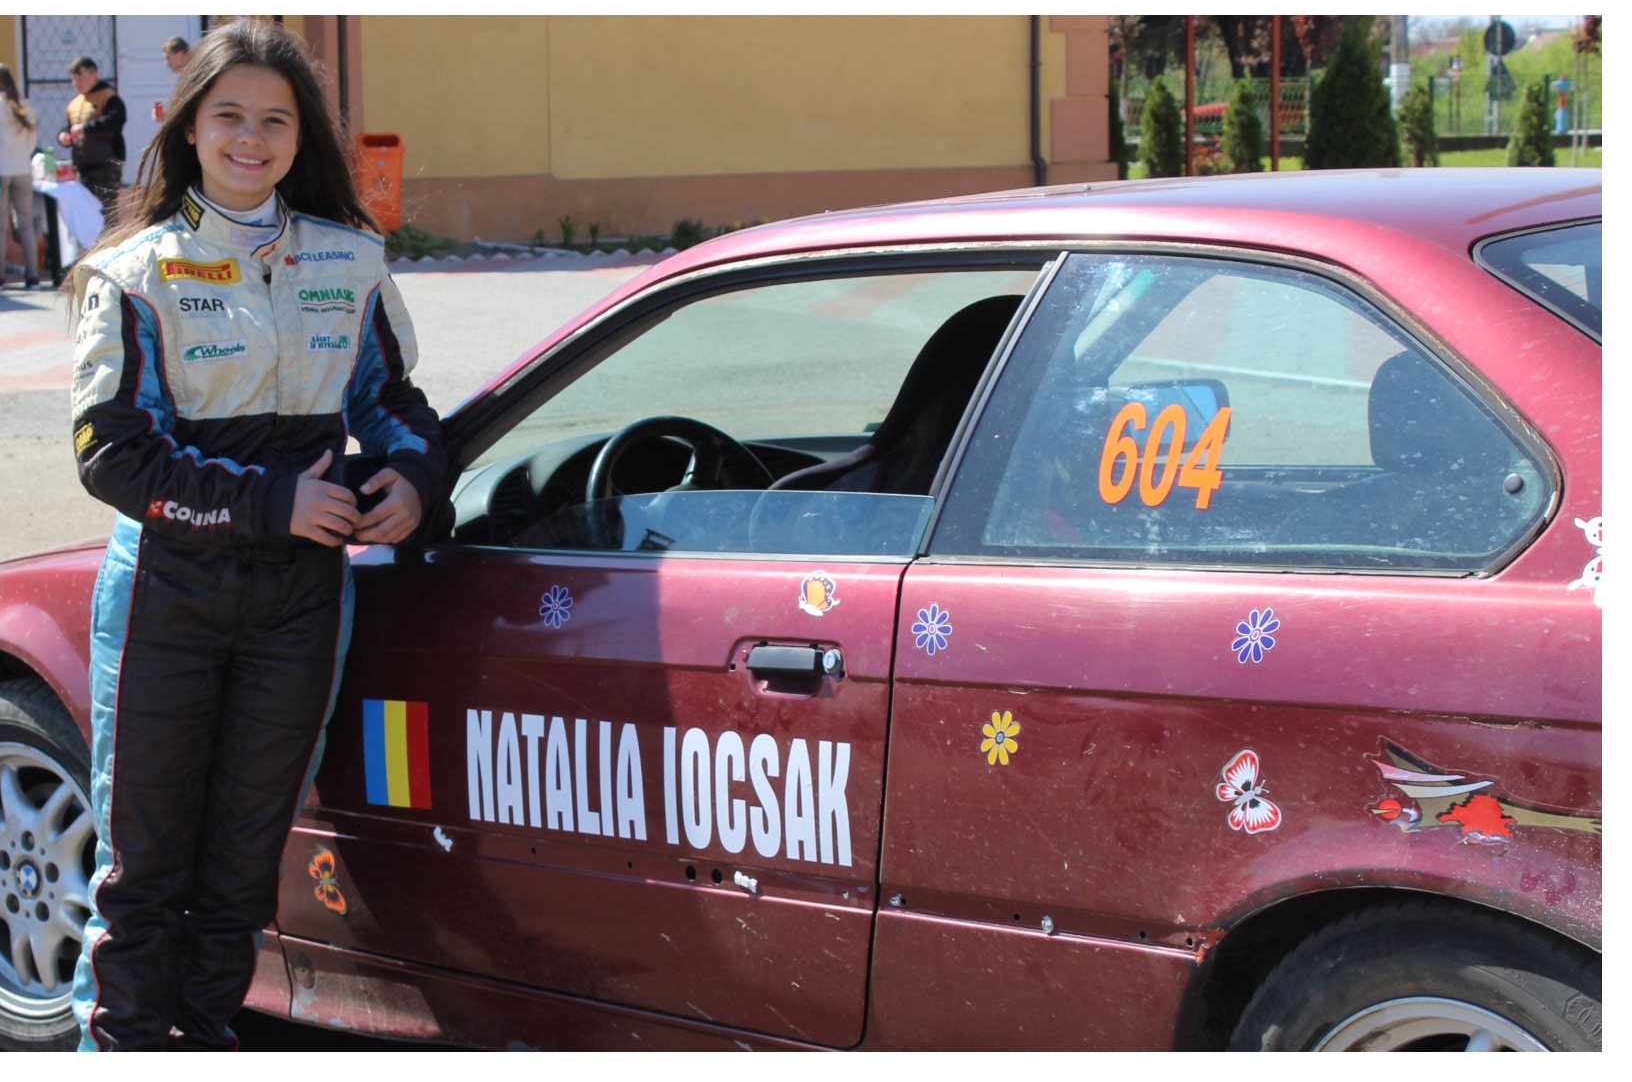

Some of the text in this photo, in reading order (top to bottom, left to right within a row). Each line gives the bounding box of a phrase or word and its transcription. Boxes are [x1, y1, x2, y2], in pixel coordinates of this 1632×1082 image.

[313, 251, 355, 262] LEASING
[165, 261, 233, 281] PIRELLI
[179, 297, 225, 312] STAR
[1098, 401, 1234, 510] 604
[466, 708, 854, 867] NATALIA IOCSAK
